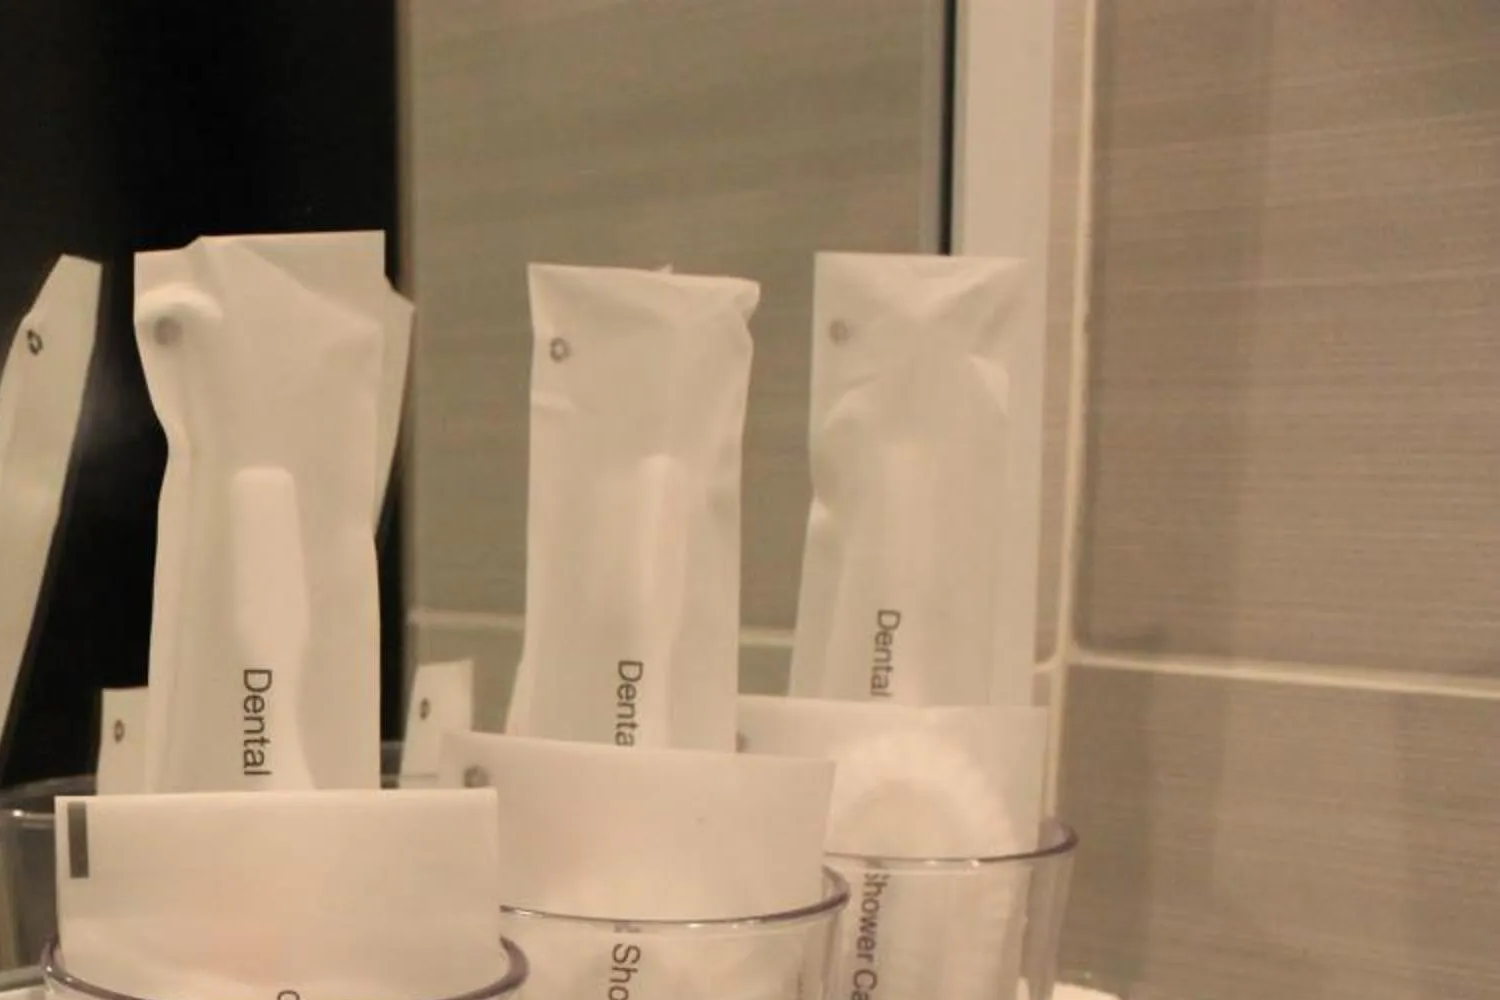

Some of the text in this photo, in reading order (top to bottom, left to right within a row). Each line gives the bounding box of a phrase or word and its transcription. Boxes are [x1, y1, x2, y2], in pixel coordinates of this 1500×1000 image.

[870, 609, 901, 697] Dental
[243, 668, 273, 777] Dental
[614, 660, 643, 747] Denta
